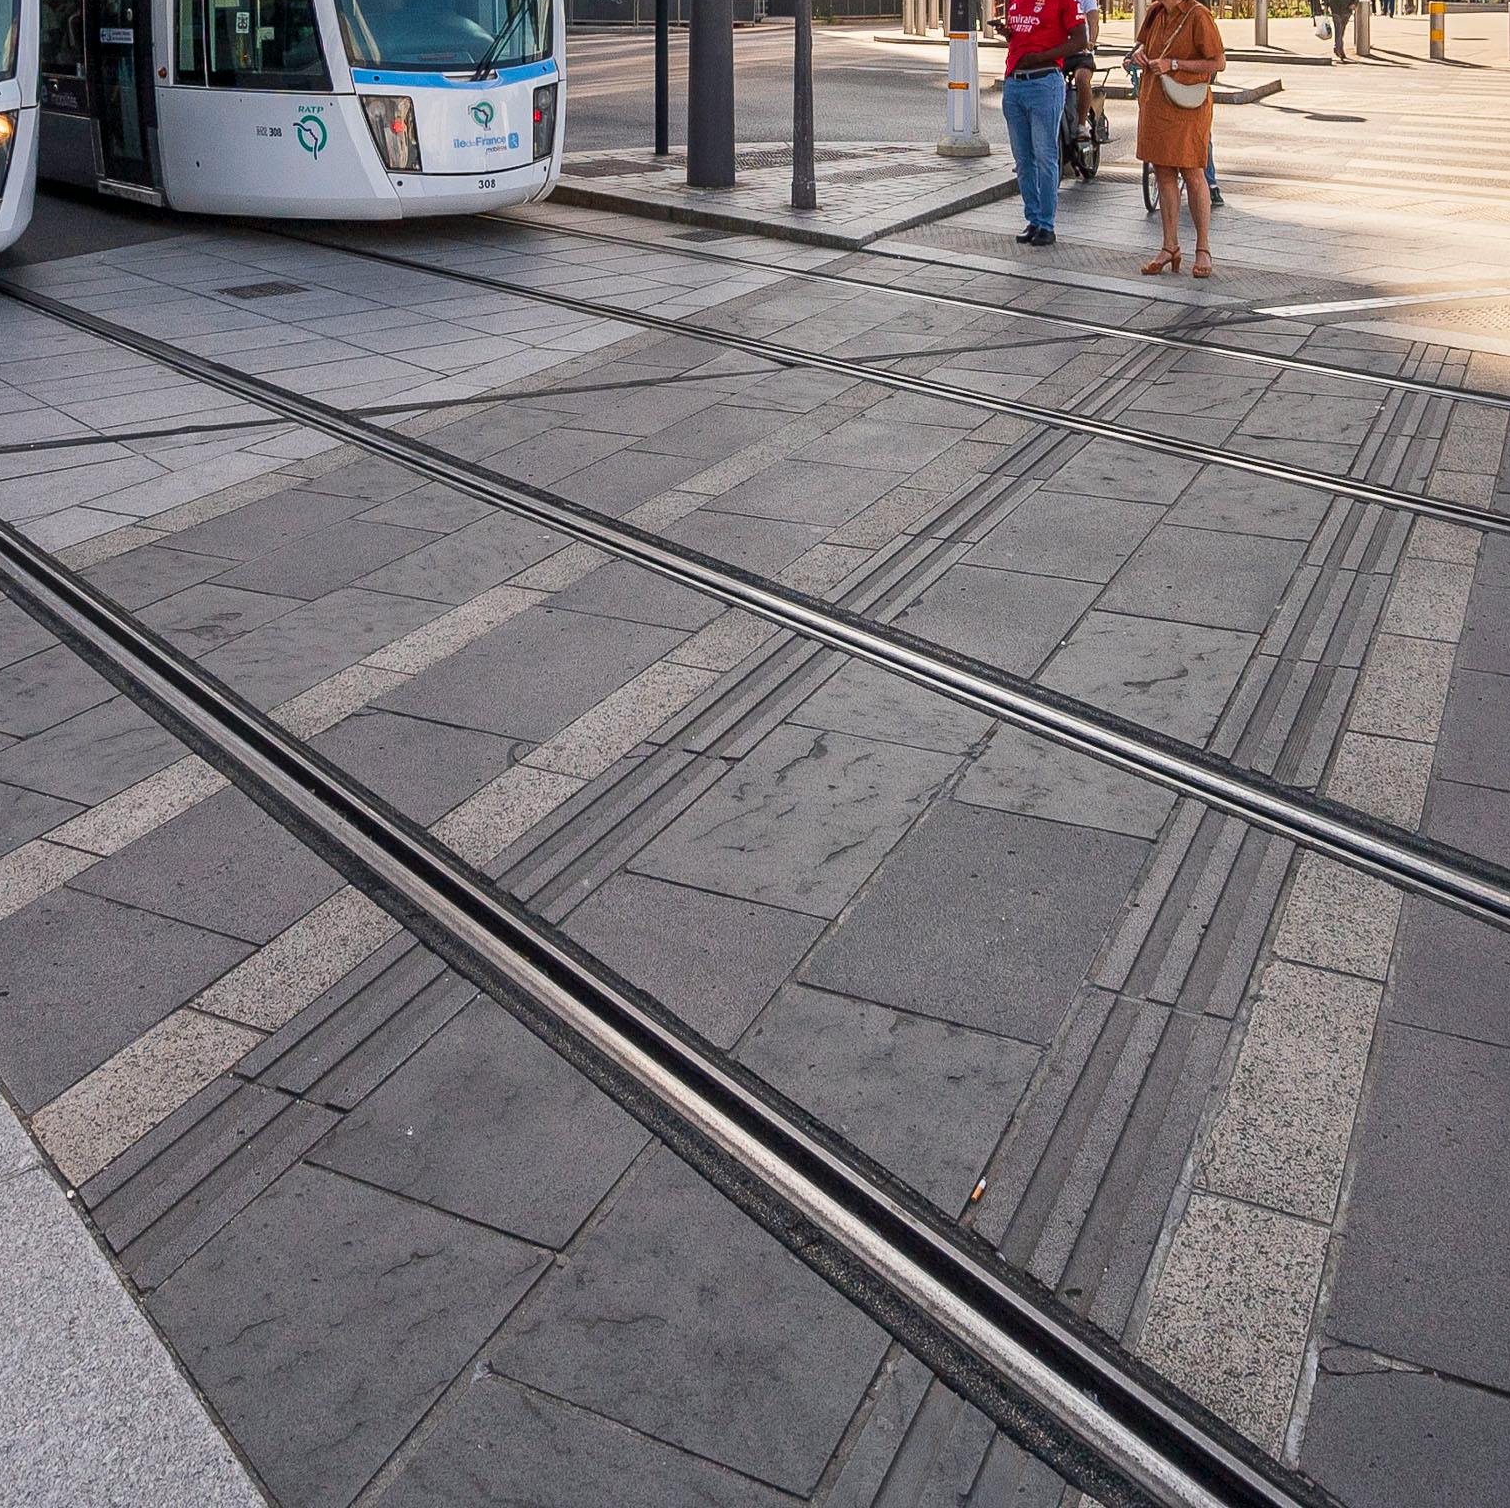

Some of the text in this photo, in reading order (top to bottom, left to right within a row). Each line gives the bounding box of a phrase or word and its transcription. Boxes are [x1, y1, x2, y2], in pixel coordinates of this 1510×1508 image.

[298, 105, 324, 113] RATP
[269, 127, 283, 137] 308
[478, 178, 496, 189] 308
